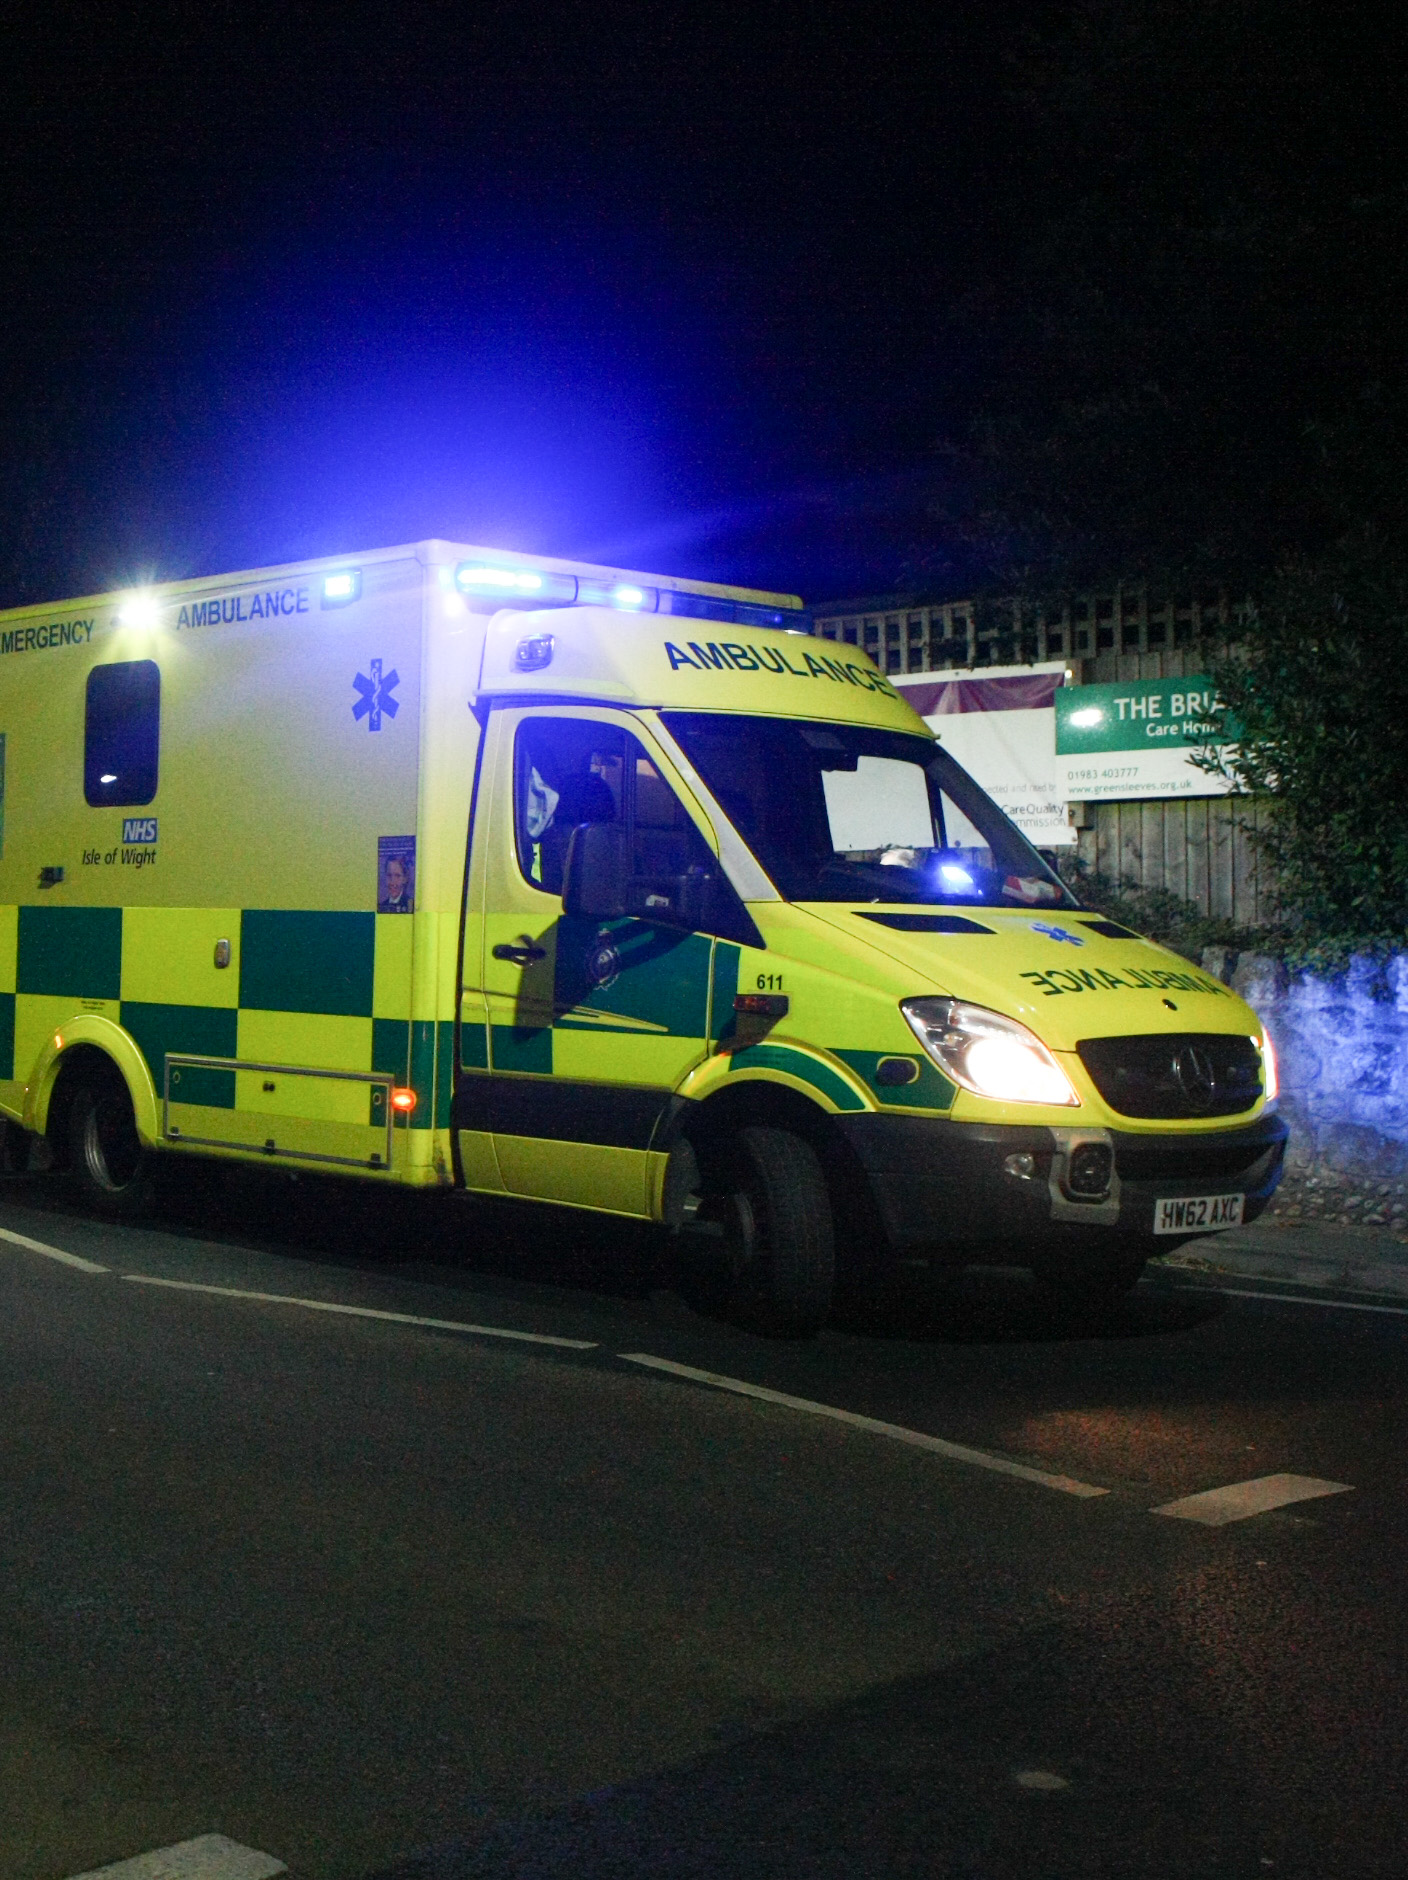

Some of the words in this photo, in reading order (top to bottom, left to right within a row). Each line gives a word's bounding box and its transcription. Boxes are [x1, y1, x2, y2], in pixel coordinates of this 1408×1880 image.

[177, 586, 310, 631] AMBULANCE
[664, 641, 897, 699] AMBULANCE
[1113, 695, 1163, 720] THE
[1146, 722, 1179, 736] Care
[1067, 769, 1098, 781] 01983
[1101, 767, 1139, 778] 403777
[1067, 779, 1193, 795] www.greensleeves.org.uk
[123, 819, 156, 841] NHS
[82, 848, 101, 865] Isle
[104, 847, 119, 865] of
[121, 847, 157, 869] Wight
[756, 974, 784, 991] 611
[1161, 1200, 1208, 1229] HW62
[1209, 1197, 1239, 1225] AXC
